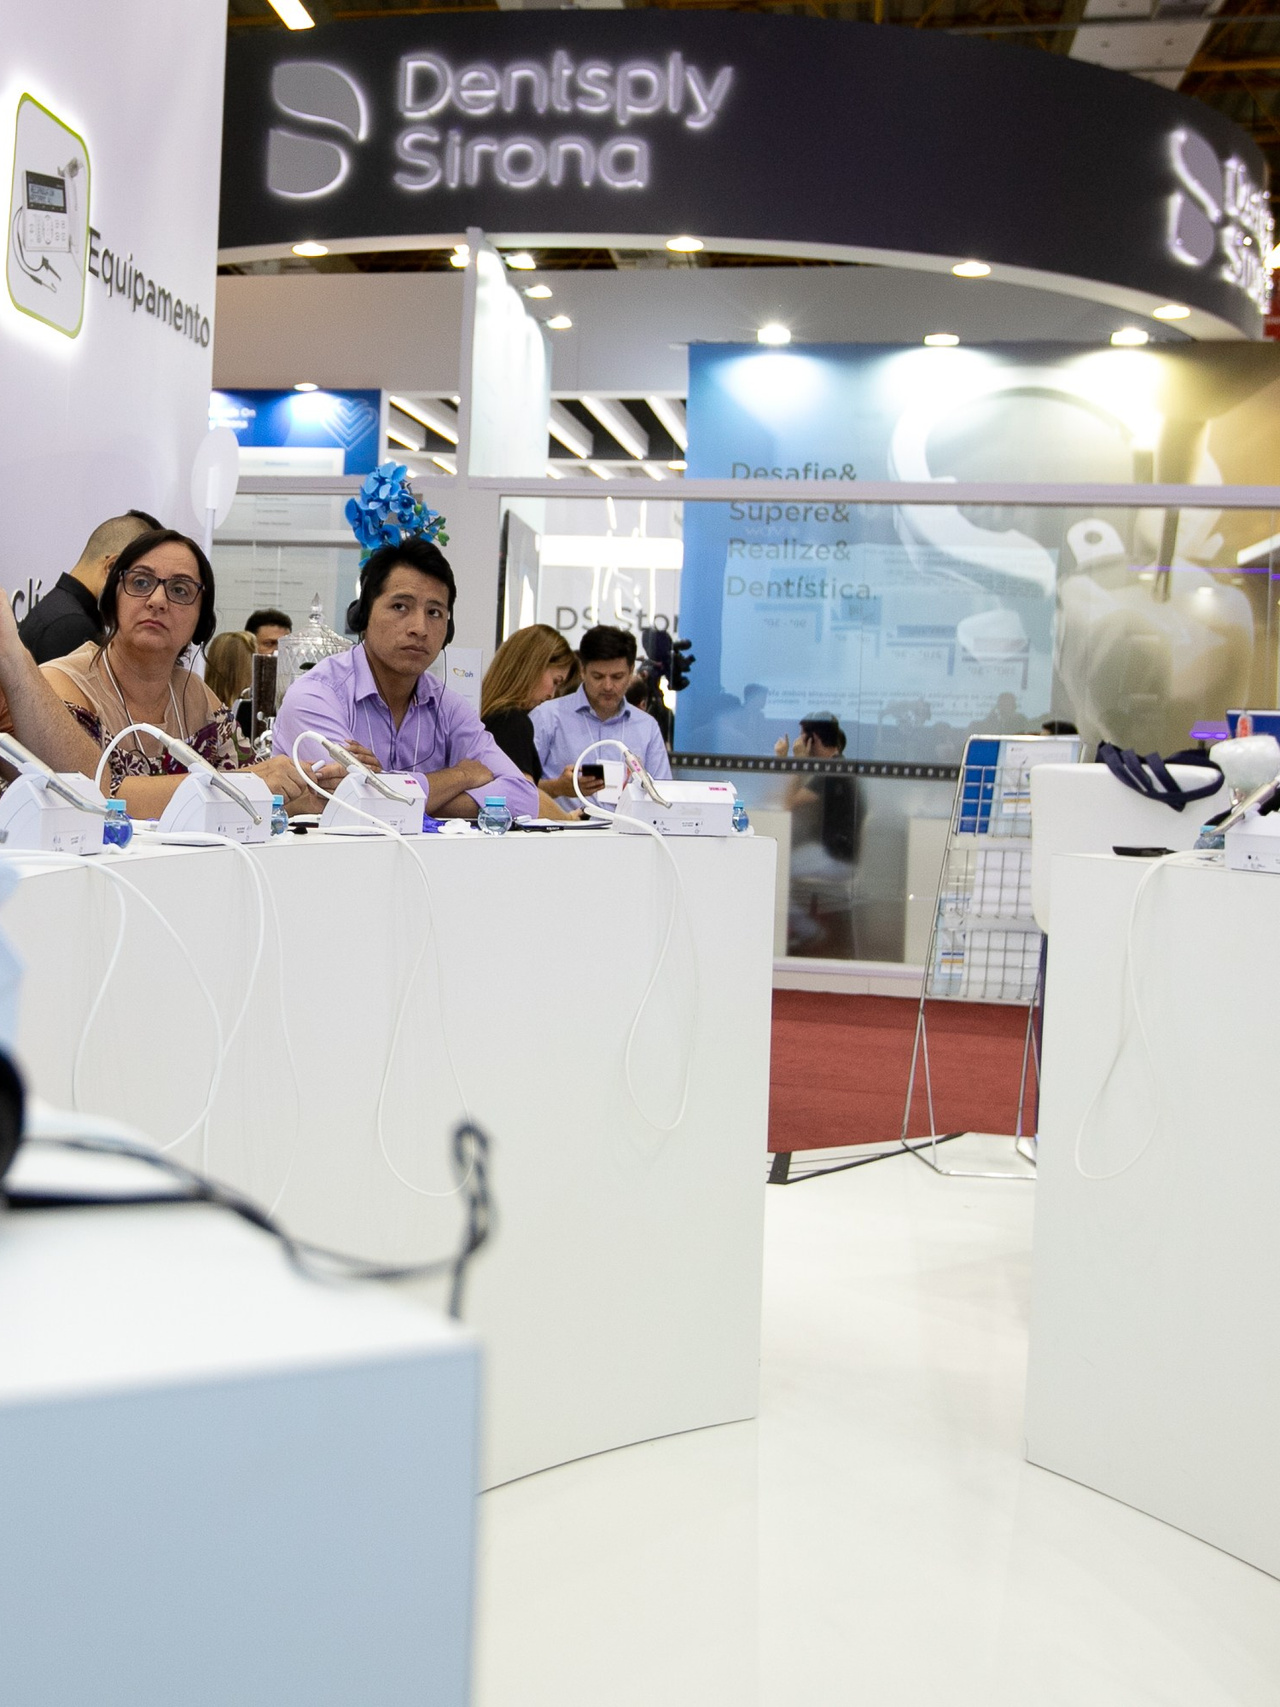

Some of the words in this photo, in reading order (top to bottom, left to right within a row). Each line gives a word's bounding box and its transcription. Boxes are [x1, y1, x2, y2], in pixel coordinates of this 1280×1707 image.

[398, 50, 733, 130] Dentsply
[394, 126, 648, 191] Sirona
[88, 226, 211, 347] Equipamento
[729, 502, 850, 525] Supere&
[728, 538, 851, 561] Realize&
[726, 575, 878, 601] Dentística.
